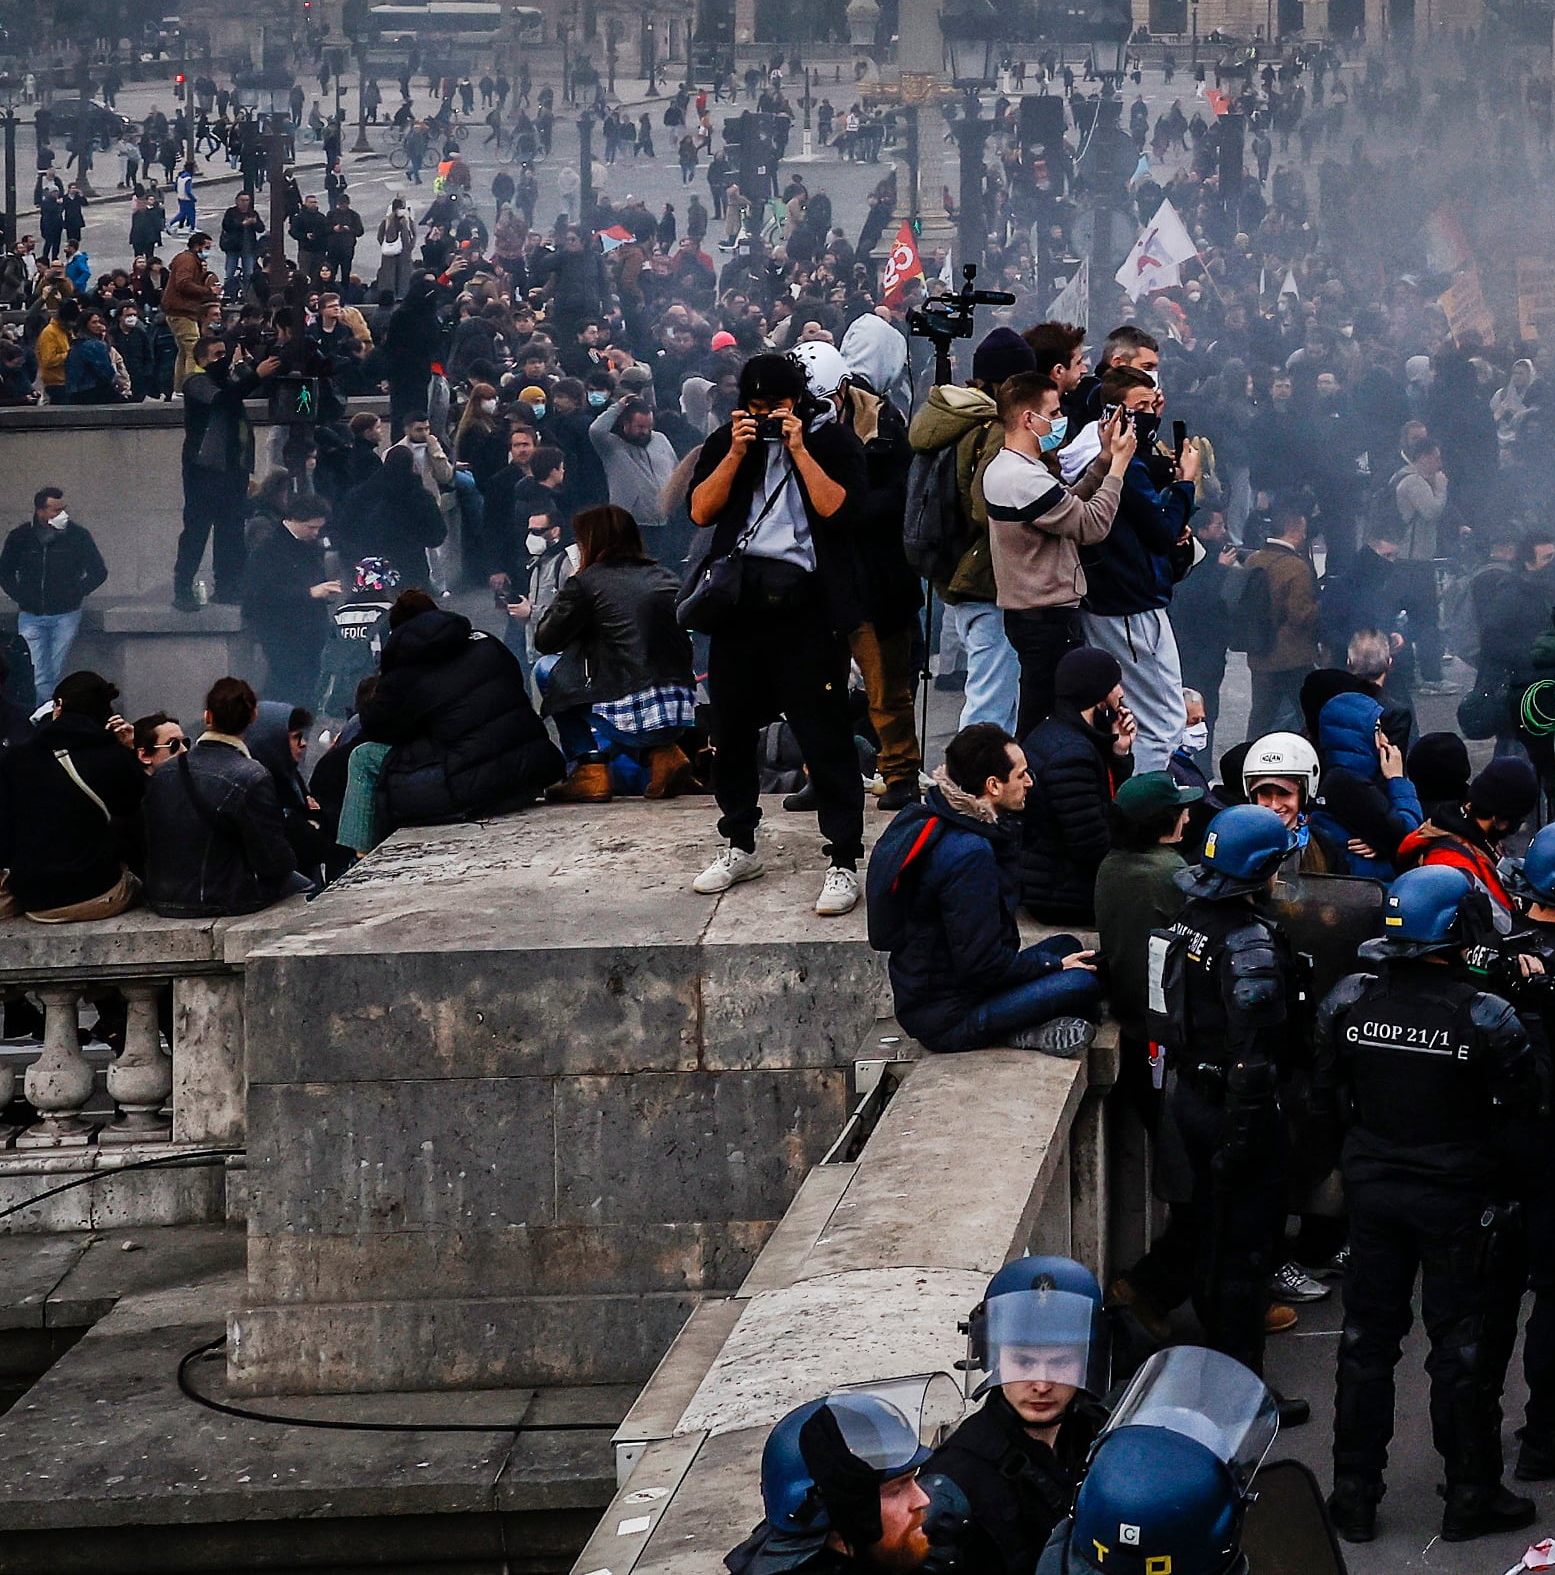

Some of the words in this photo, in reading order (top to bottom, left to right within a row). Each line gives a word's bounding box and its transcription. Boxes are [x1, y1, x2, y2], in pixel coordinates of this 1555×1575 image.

[341, 626, 368, 639] EDIC
[1346, 1026, 1359, 1043] G
[1363, 1020, 1403, 1041] CIOP
[1406, 1027, 1450, 1049] 21/1
[1457, 1044, 1470, 1060] E
[1123, 1527, 1136, 1541] C
